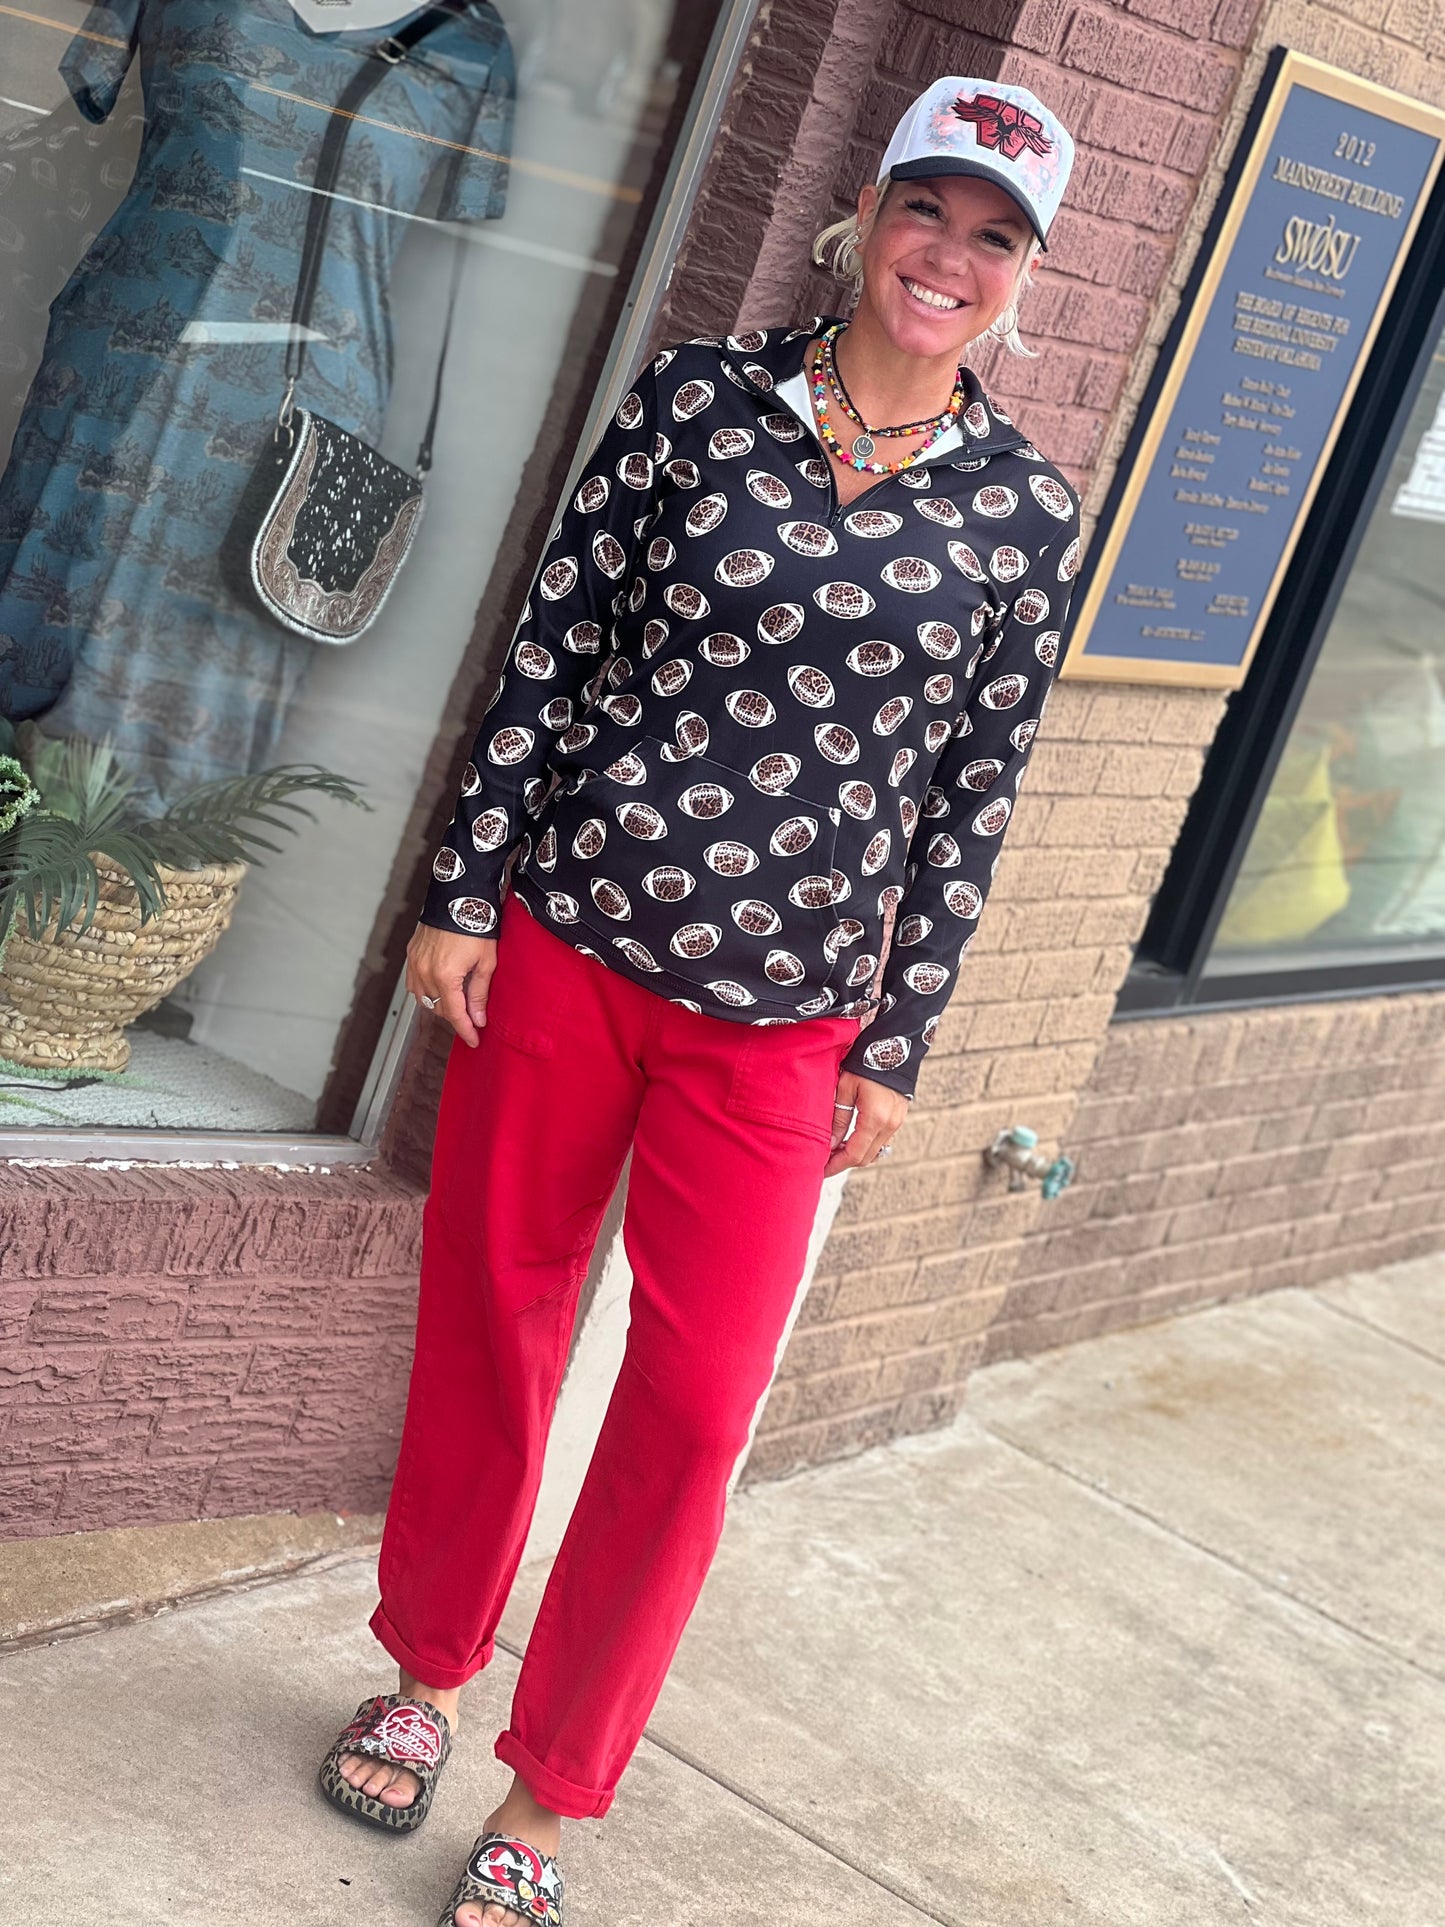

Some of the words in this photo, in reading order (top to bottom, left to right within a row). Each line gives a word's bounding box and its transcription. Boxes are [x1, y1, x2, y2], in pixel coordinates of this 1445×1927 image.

[1333, 132, 1377, 167] 2012
[1273, 156, 1351, 203] MAINSTREET
[1346, 179, 1405, 219] BUILDING
[1275, 213, 1361, 280] SWOSU
[393, 1742, 414, 1757] MADE
